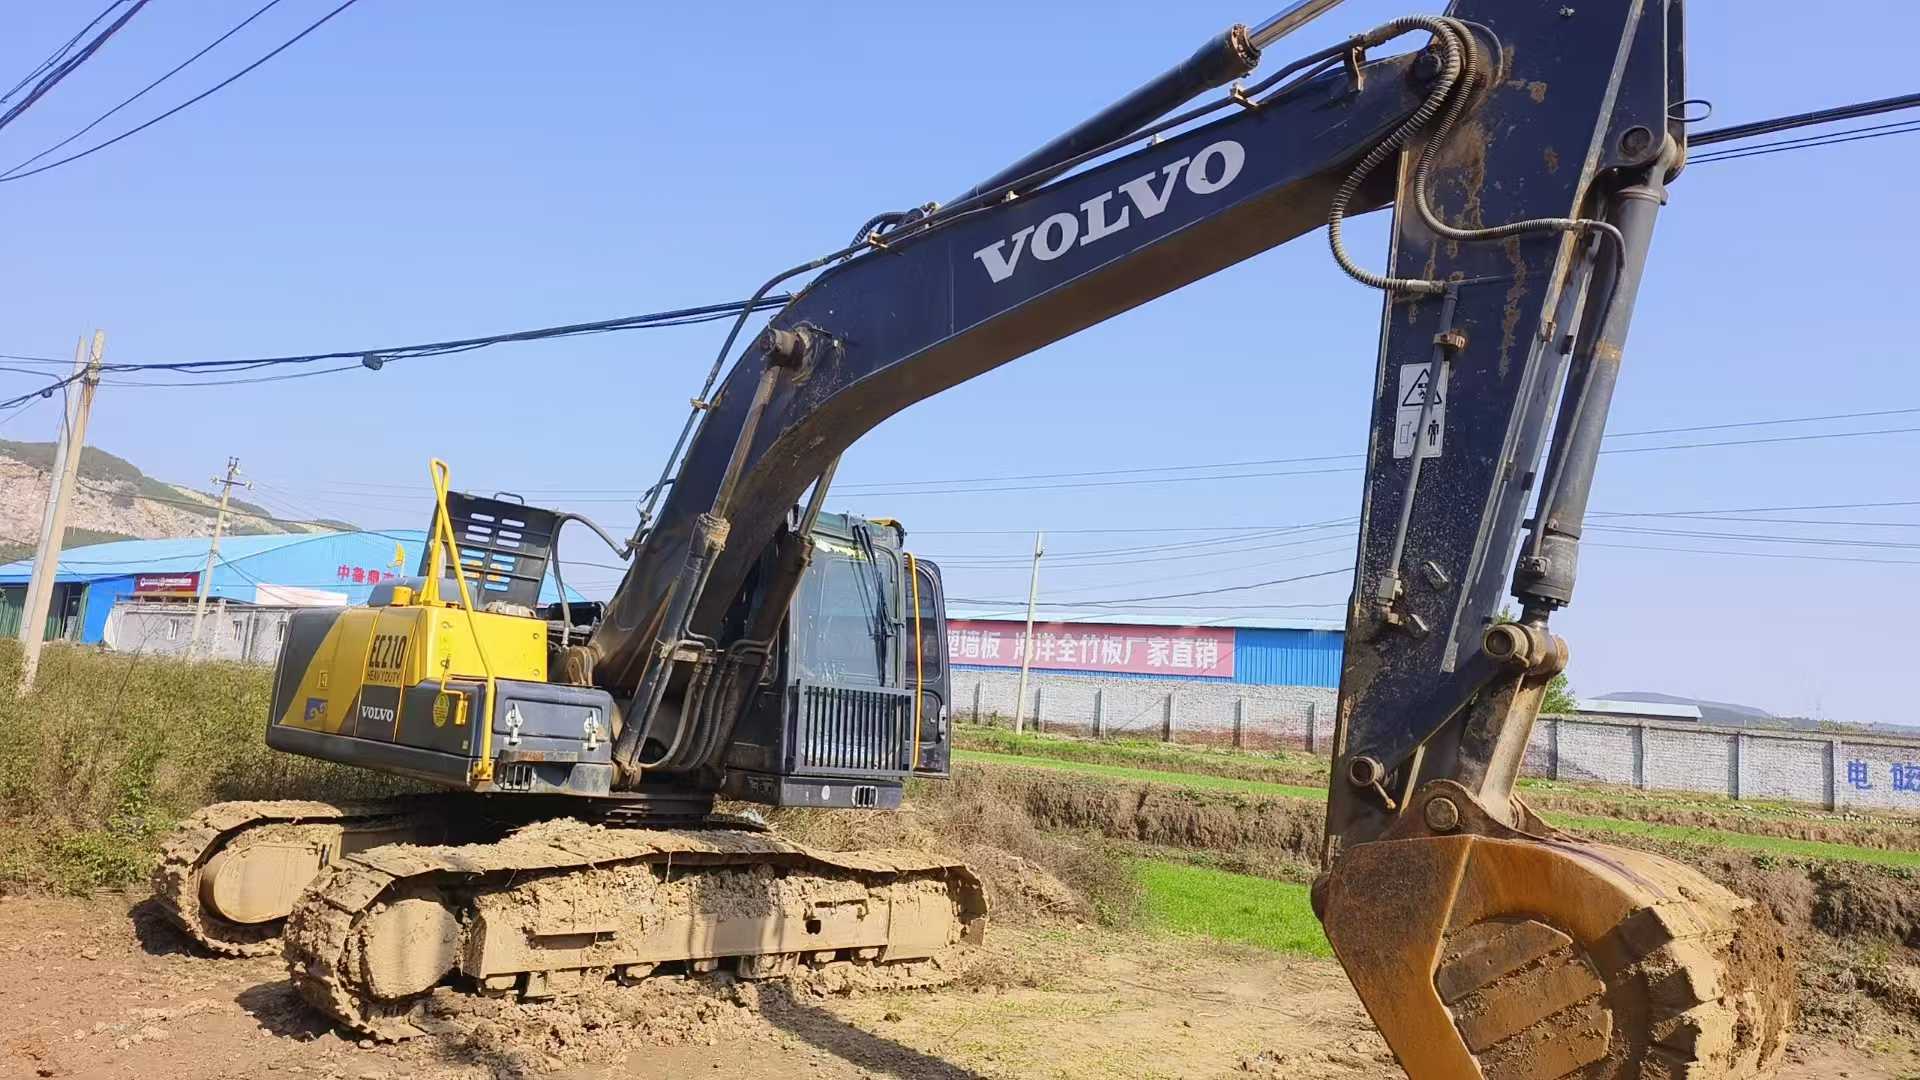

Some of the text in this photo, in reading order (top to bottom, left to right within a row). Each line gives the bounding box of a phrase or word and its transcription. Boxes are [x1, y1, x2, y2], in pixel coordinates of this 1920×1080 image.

[974, 141, 1245, 283] VOLVO
[369, 634, 407, 669] EC210
[361, 705, 394, 722] VOLVO
